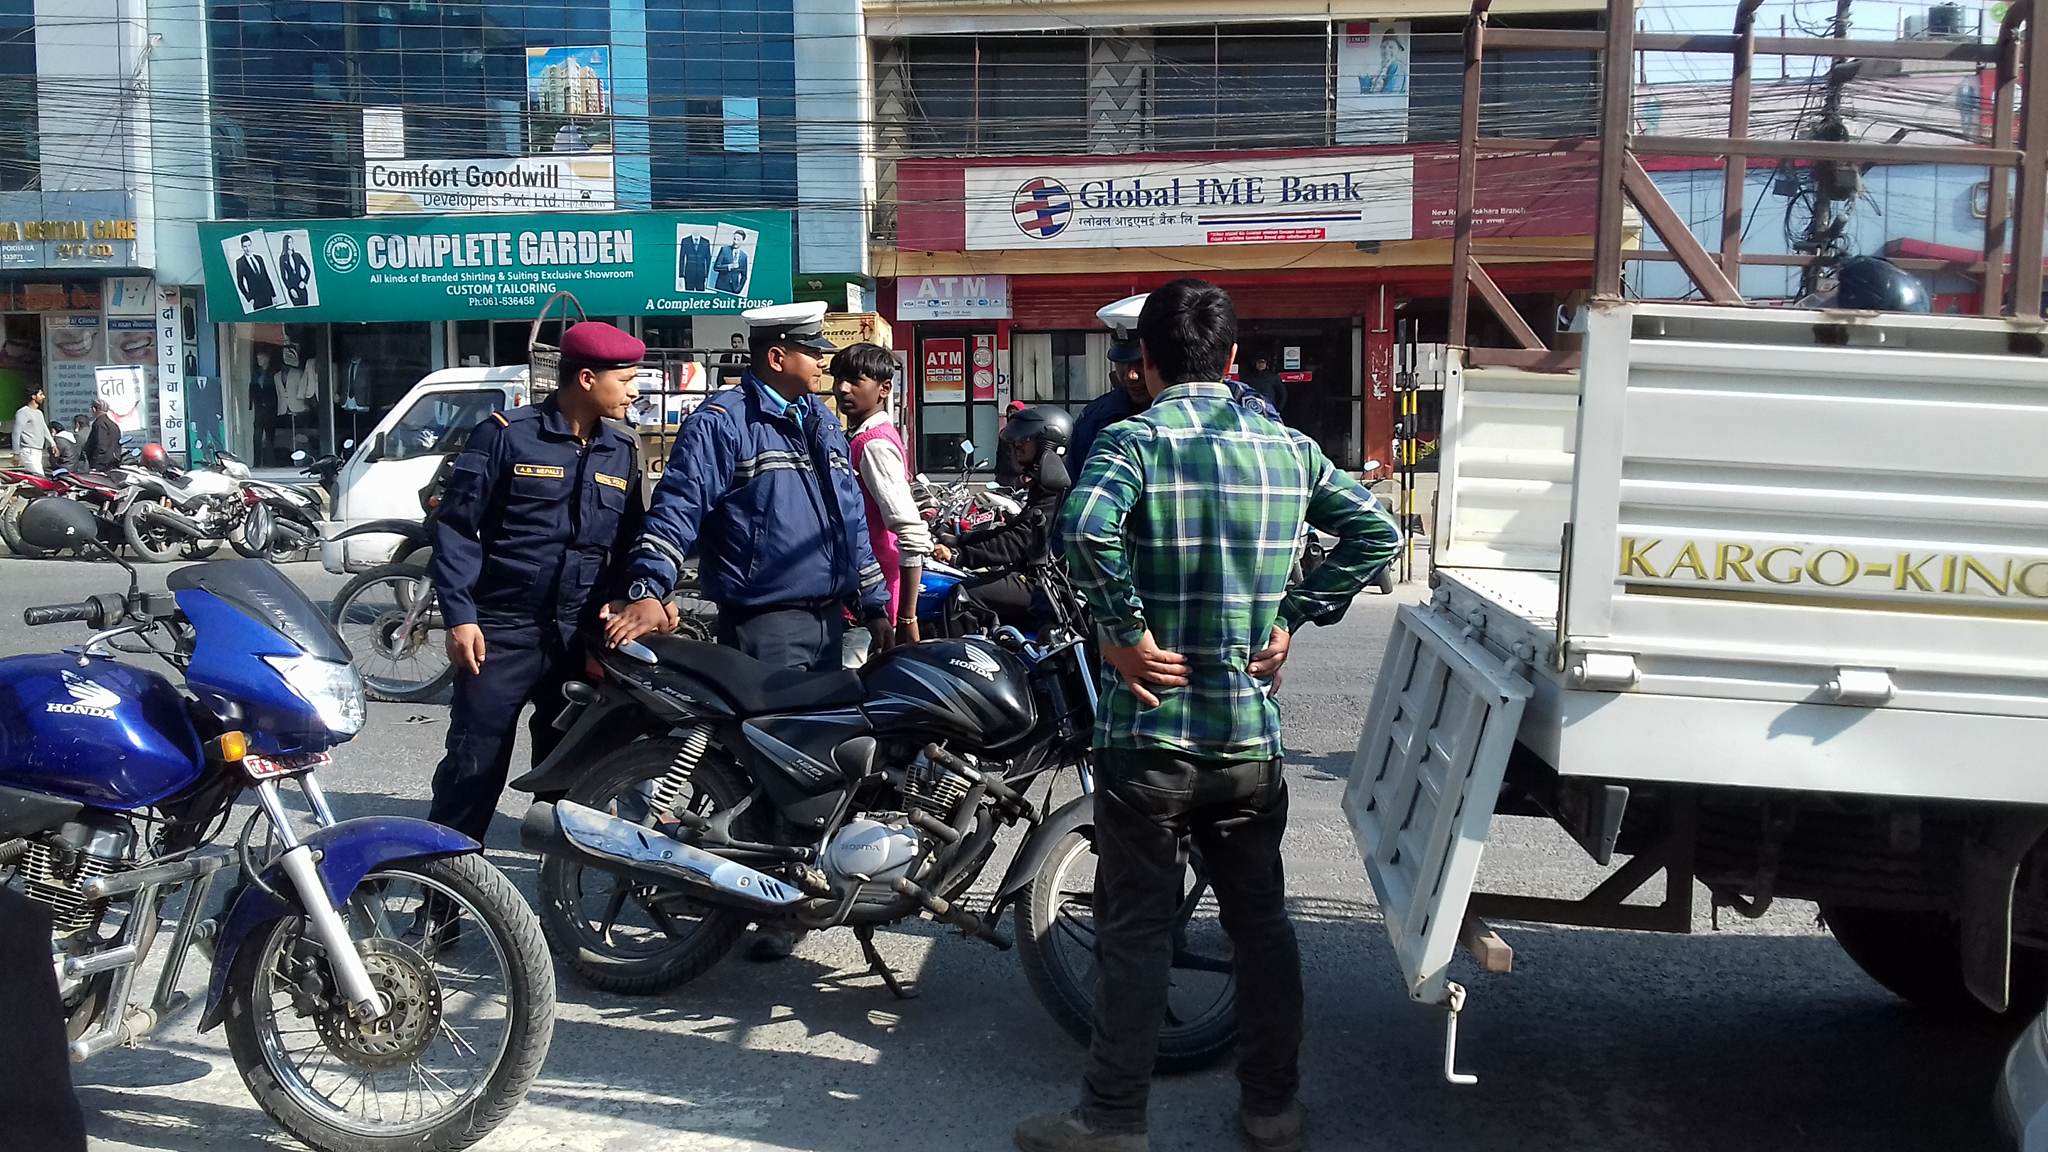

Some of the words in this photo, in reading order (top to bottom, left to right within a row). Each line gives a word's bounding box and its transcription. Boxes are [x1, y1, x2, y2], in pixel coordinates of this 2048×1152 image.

[371, 164, 459, 188] Comfort
[465, 163, 559, 188] Goodwill
[1079, 178, 1183, 209] Global
[1195, 177, 1265, 206] IME
[1279, 171, 1364, 203] Bank
[423, 191, 498, 210] Developers
[503, 193, 530, 208] Pvt.
[534, 191, 561, 208] Ltd.
[92, 219, 138, 240] CARE
[366, 232, 513, 270] COMPLETE
[519, 229, 634, 266] GARDEN
[370, 274, 382, 284] All
[384, 273, 408, 284] kinds
[409, 272, 420, 283] of
[421, 272, 458, 283] Branded
[460, 271, 496, 282] Shirting
[498, 271, 505, 281] &
[507, 270, 539, 281] Suiting
[541, 269, 582, 280] Exclusive
[584, 268, 634, 279] Showroom
[446, 284, 493, 296] CUSTOM
[496, 282, 557, 295] TAILORING
[916, 277, 987, 299] ATM
[645, 299, 655, 310] A
[656, 297, 711, 312] Complete
[712, 297, 736, 310] Suit
[737, 299, 773, 309] House
[926, 351, 962, 366] ATM
[948, 658, 995, 682] HONDA
[46, 702, 118, 721] HONDA
